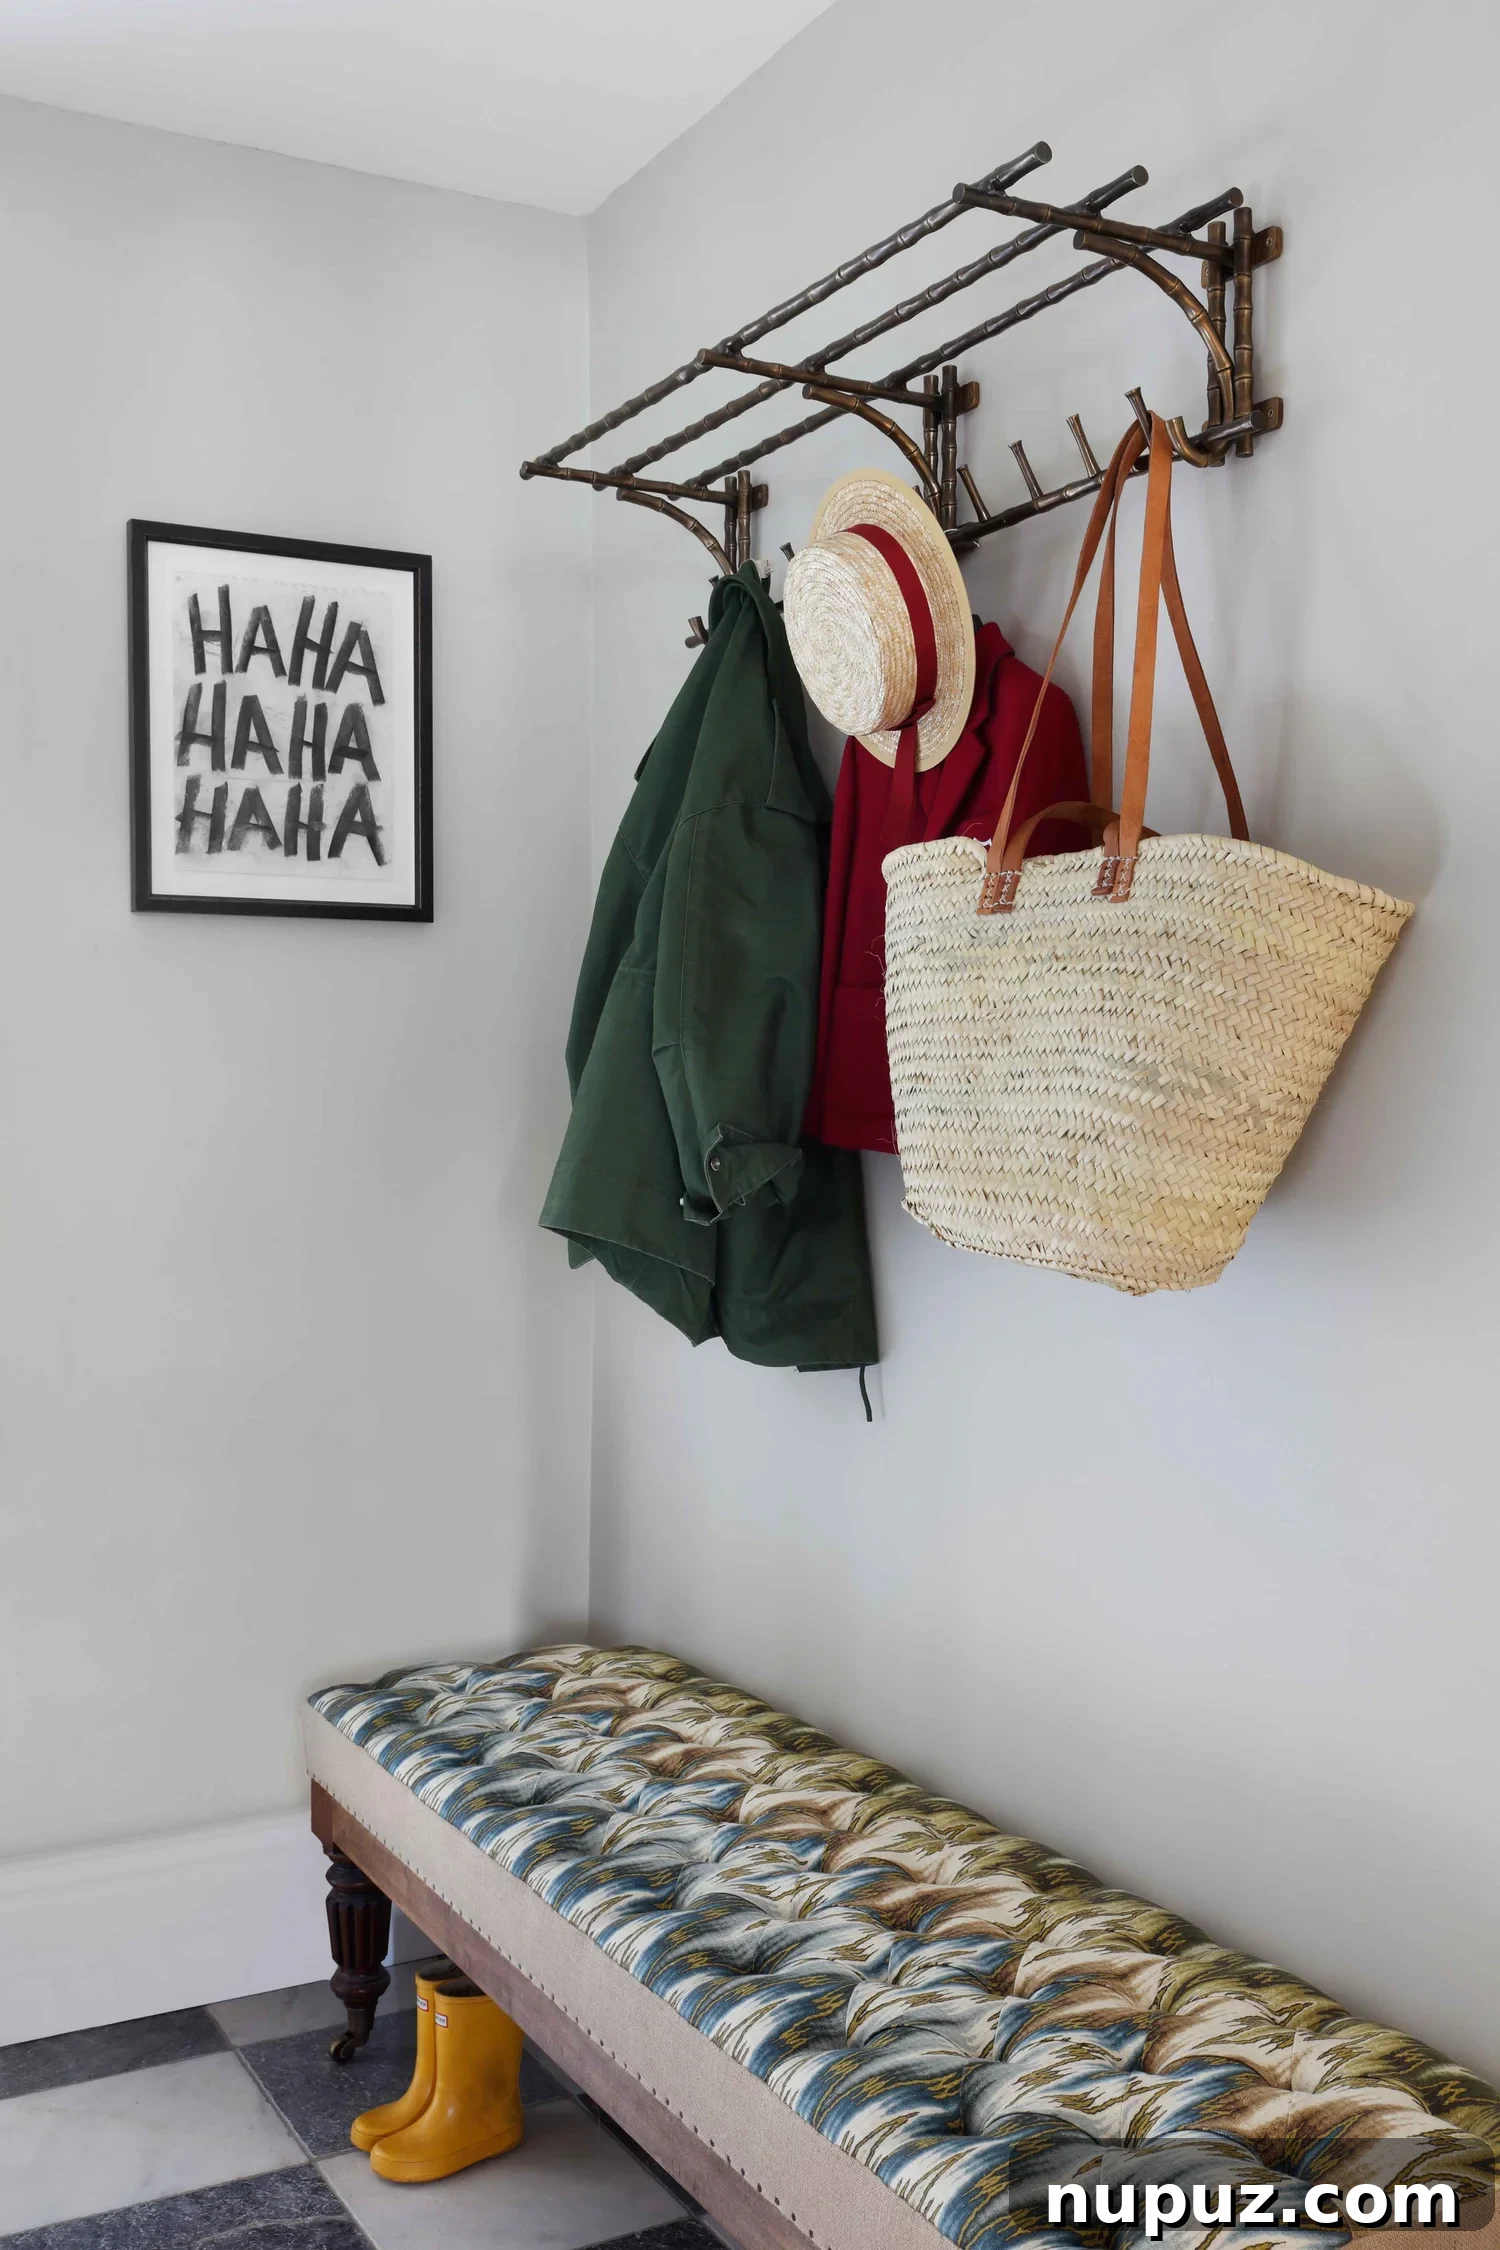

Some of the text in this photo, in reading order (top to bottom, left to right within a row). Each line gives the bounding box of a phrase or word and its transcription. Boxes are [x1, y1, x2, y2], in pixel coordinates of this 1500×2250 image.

[187, 583, 385, 706] HAHA
[174, 679, 381, 782] HAHA
[174, 774, 388, 867] HAHA
